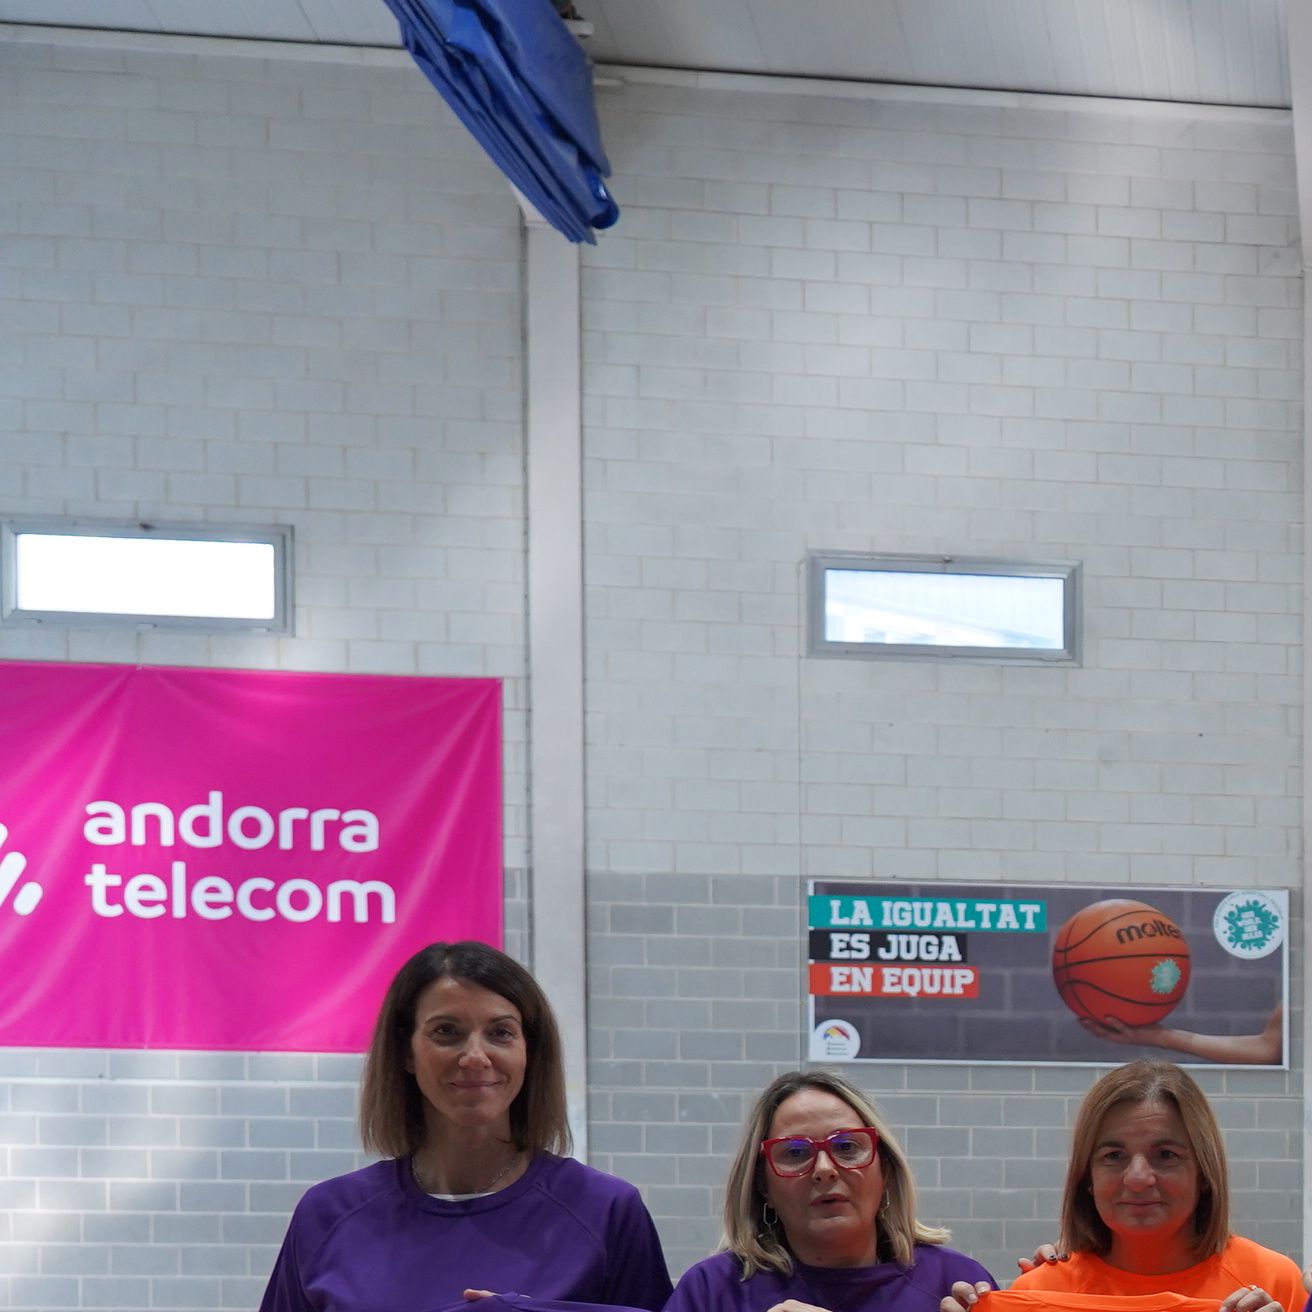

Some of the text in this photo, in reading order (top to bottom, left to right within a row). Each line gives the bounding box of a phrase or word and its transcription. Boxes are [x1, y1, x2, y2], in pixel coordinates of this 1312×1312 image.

[83, 791, 379, 853] andorra
[84, 861, 396, 923] telecom
[830, 900, 1040, 931] LA IGUALTAT
[830, 933, 962, 962] ES JUGA
[1116, 920, 1181, 944] molte
[830, 966, 975, 997] EN EQUIP
